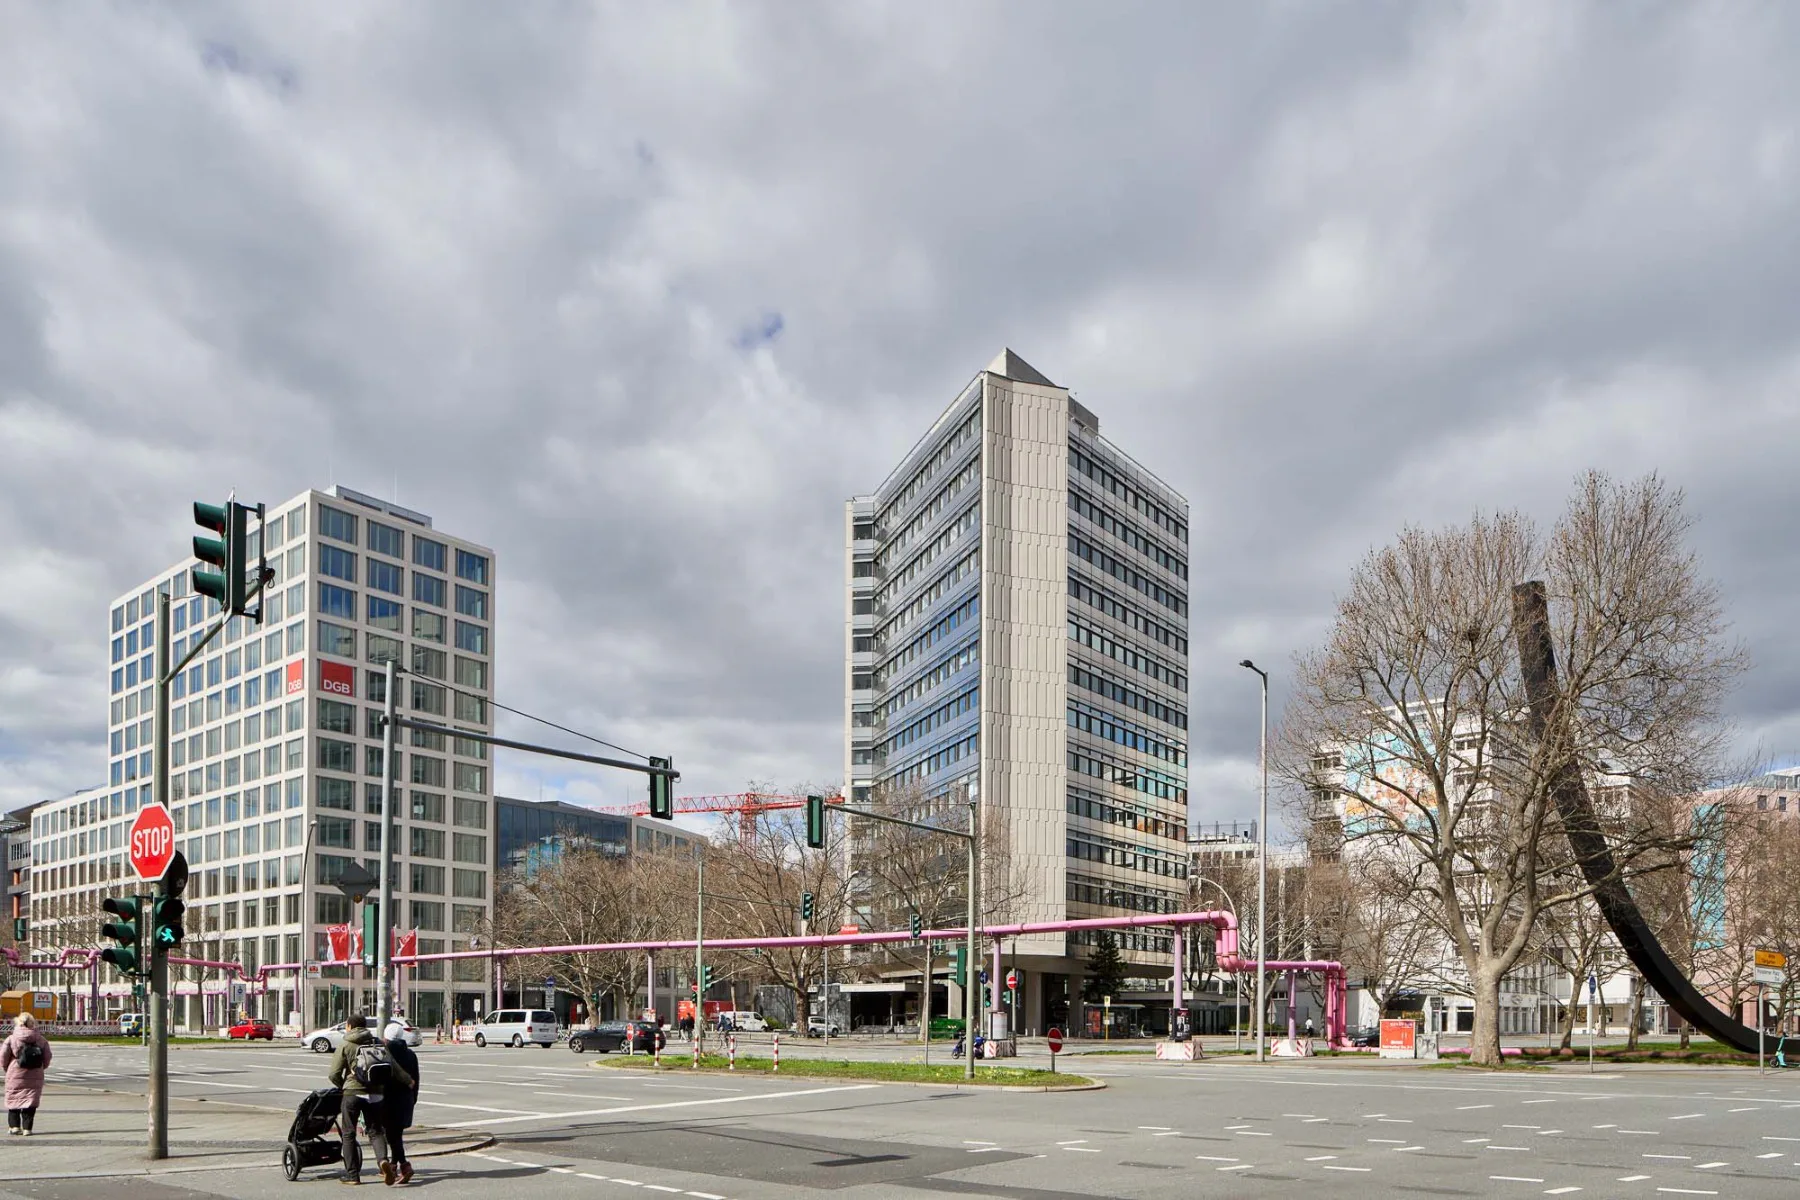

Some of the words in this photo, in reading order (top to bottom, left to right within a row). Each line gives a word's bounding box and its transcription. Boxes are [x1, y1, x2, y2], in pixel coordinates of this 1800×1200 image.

[288, 679, 302, 692] DGB
[323, 679, 350, 693] DGB
[133, 825, 170, 859] STOP
